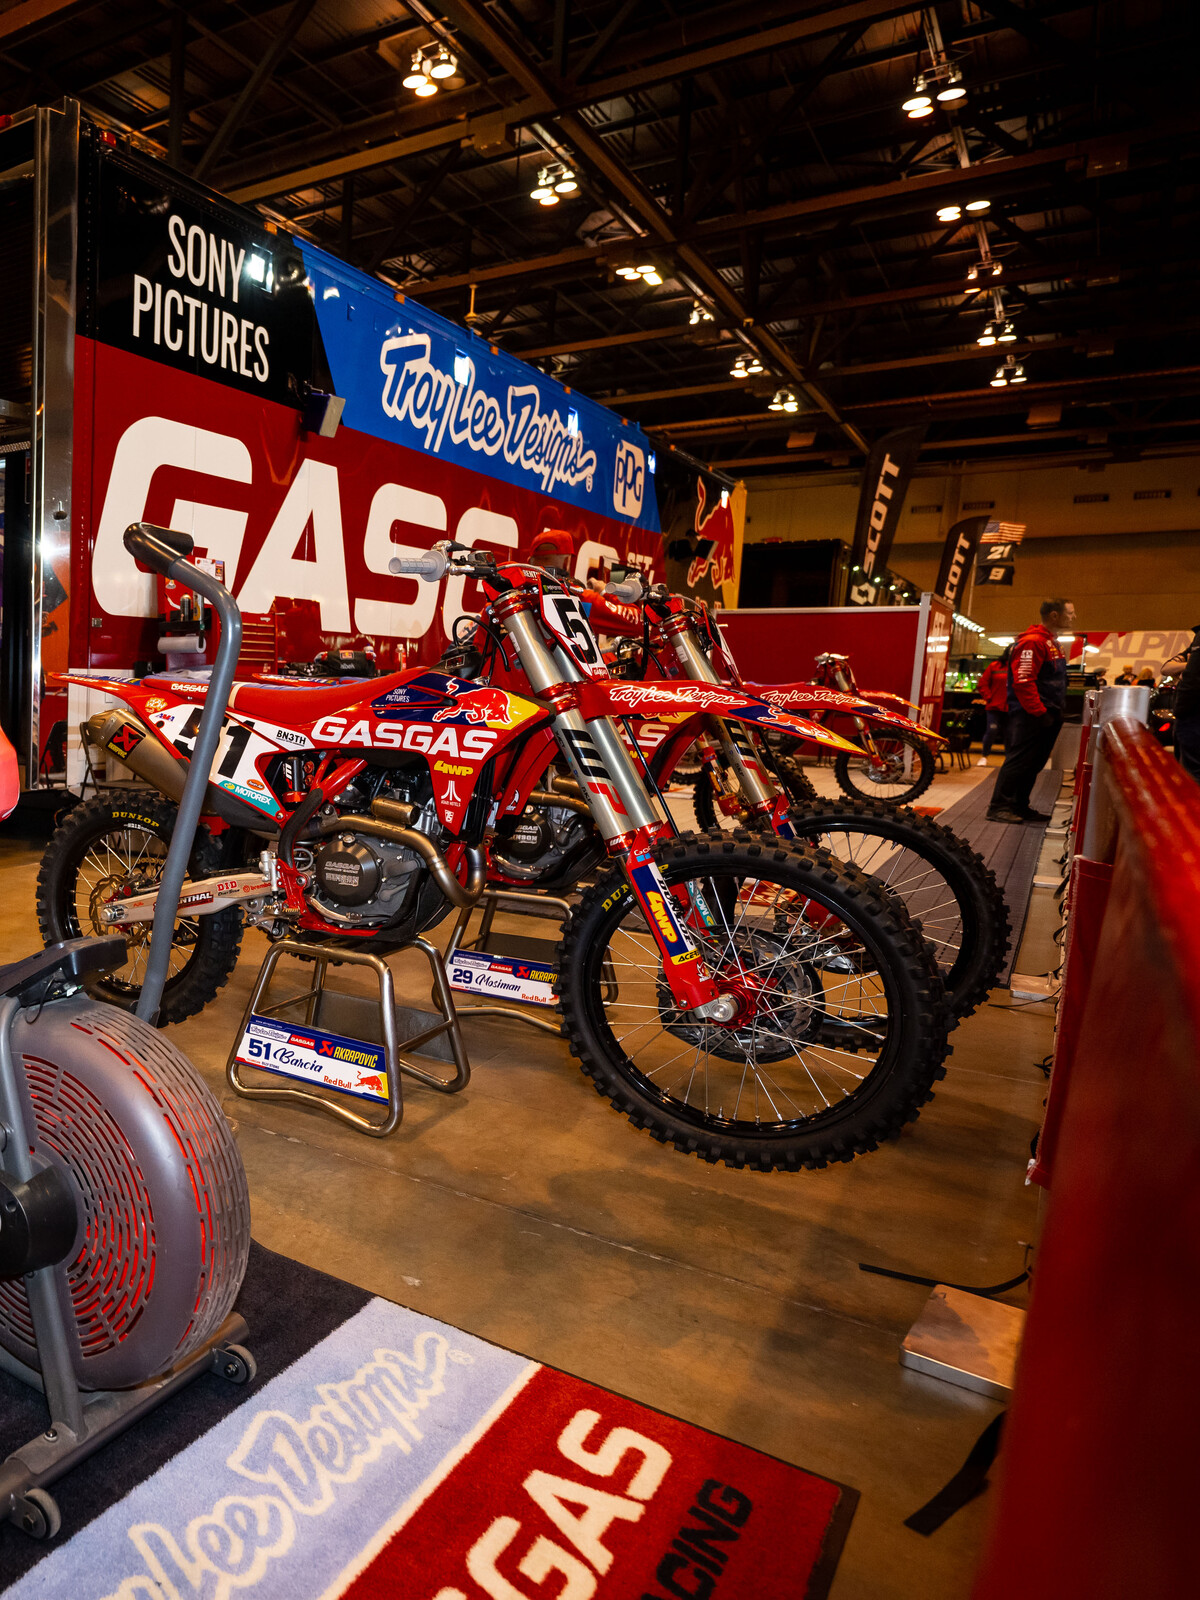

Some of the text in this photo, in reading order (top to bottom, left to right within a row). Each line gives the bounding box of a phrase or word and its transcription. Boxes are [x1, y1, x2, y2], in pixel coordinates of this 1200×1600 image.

[168, 214, 245, 303] SONY
[132, 273, 270, 383] PICTURES
[380, 333, 596, 492] Troy Lee Designs
[92, 415, 621, 640] GASG
[863, 453, 901, 585] SCOTT
[989, 544, 1012, 561] 21
[171, 683, 209, 693] GASGAS
[385, 694, 410, 703] PICTURES
[609, 685, 747, 708] Troy Lee Designs
[760, 690, 791, 706] Troy
[787, 690, 814, 702] Lee
[276, 730, 307, 745] BN3TH
[311, 716, 498, 760] GASGAS
[234, 785, 272, 806] MOTOREX
[111, 811, 160, 828] DUNLOP
[324, 861, 361, 871] GASGAS
[180, 892, 213, 904] NTHAL
[452, 968, 473, 984] 29
[475, 973, 521, 992] Mosiman
[529, 969, 558, 984] AKRAPO
[521, 993, 534, 1001] Red
[290, 1036, 315, 1047] GASGAS
[248, 1037, 324, 1073] 51 Barcia
[333, 1046, 379, 1068] AKRAPOVIČ
[323, 1075, 352, 1090] Red Bull
[228, 1330, 451, 1515] Designs
[432, 1408, 673, 1600] GAS
[642, 1477, 754, 1600] CING
